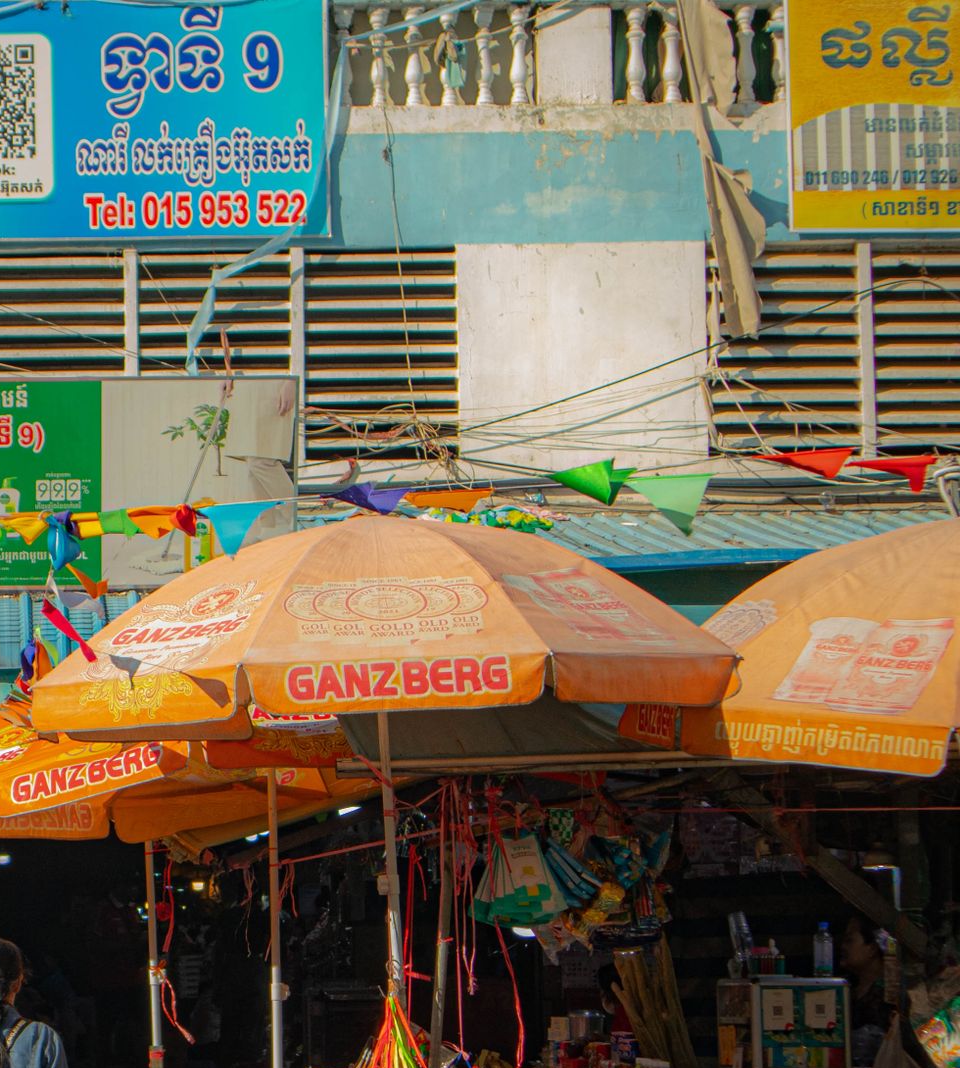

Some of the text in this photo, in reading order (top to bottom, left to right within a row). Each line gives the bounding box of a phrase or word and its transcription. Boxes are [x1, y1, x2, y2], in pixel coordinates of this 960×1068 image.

[805, 171, 828, 185] 011
[902, 170, 926, 184] 012
[84, 190, 307, 228] Tel: 015 953 522
[112, 614, 250, 647] GANZBERG
[334, 624, 363, 632] GOL
[369, 623, 414, 632] GOLD
[419, 619, 449, 628] OLD
[453, 616, 479, 624] OLD
[371, 630, 416, 638] AWARD
[287, 654, 513, 704] GANZBERG
[11, 741, 163, 804] GANZBERG
